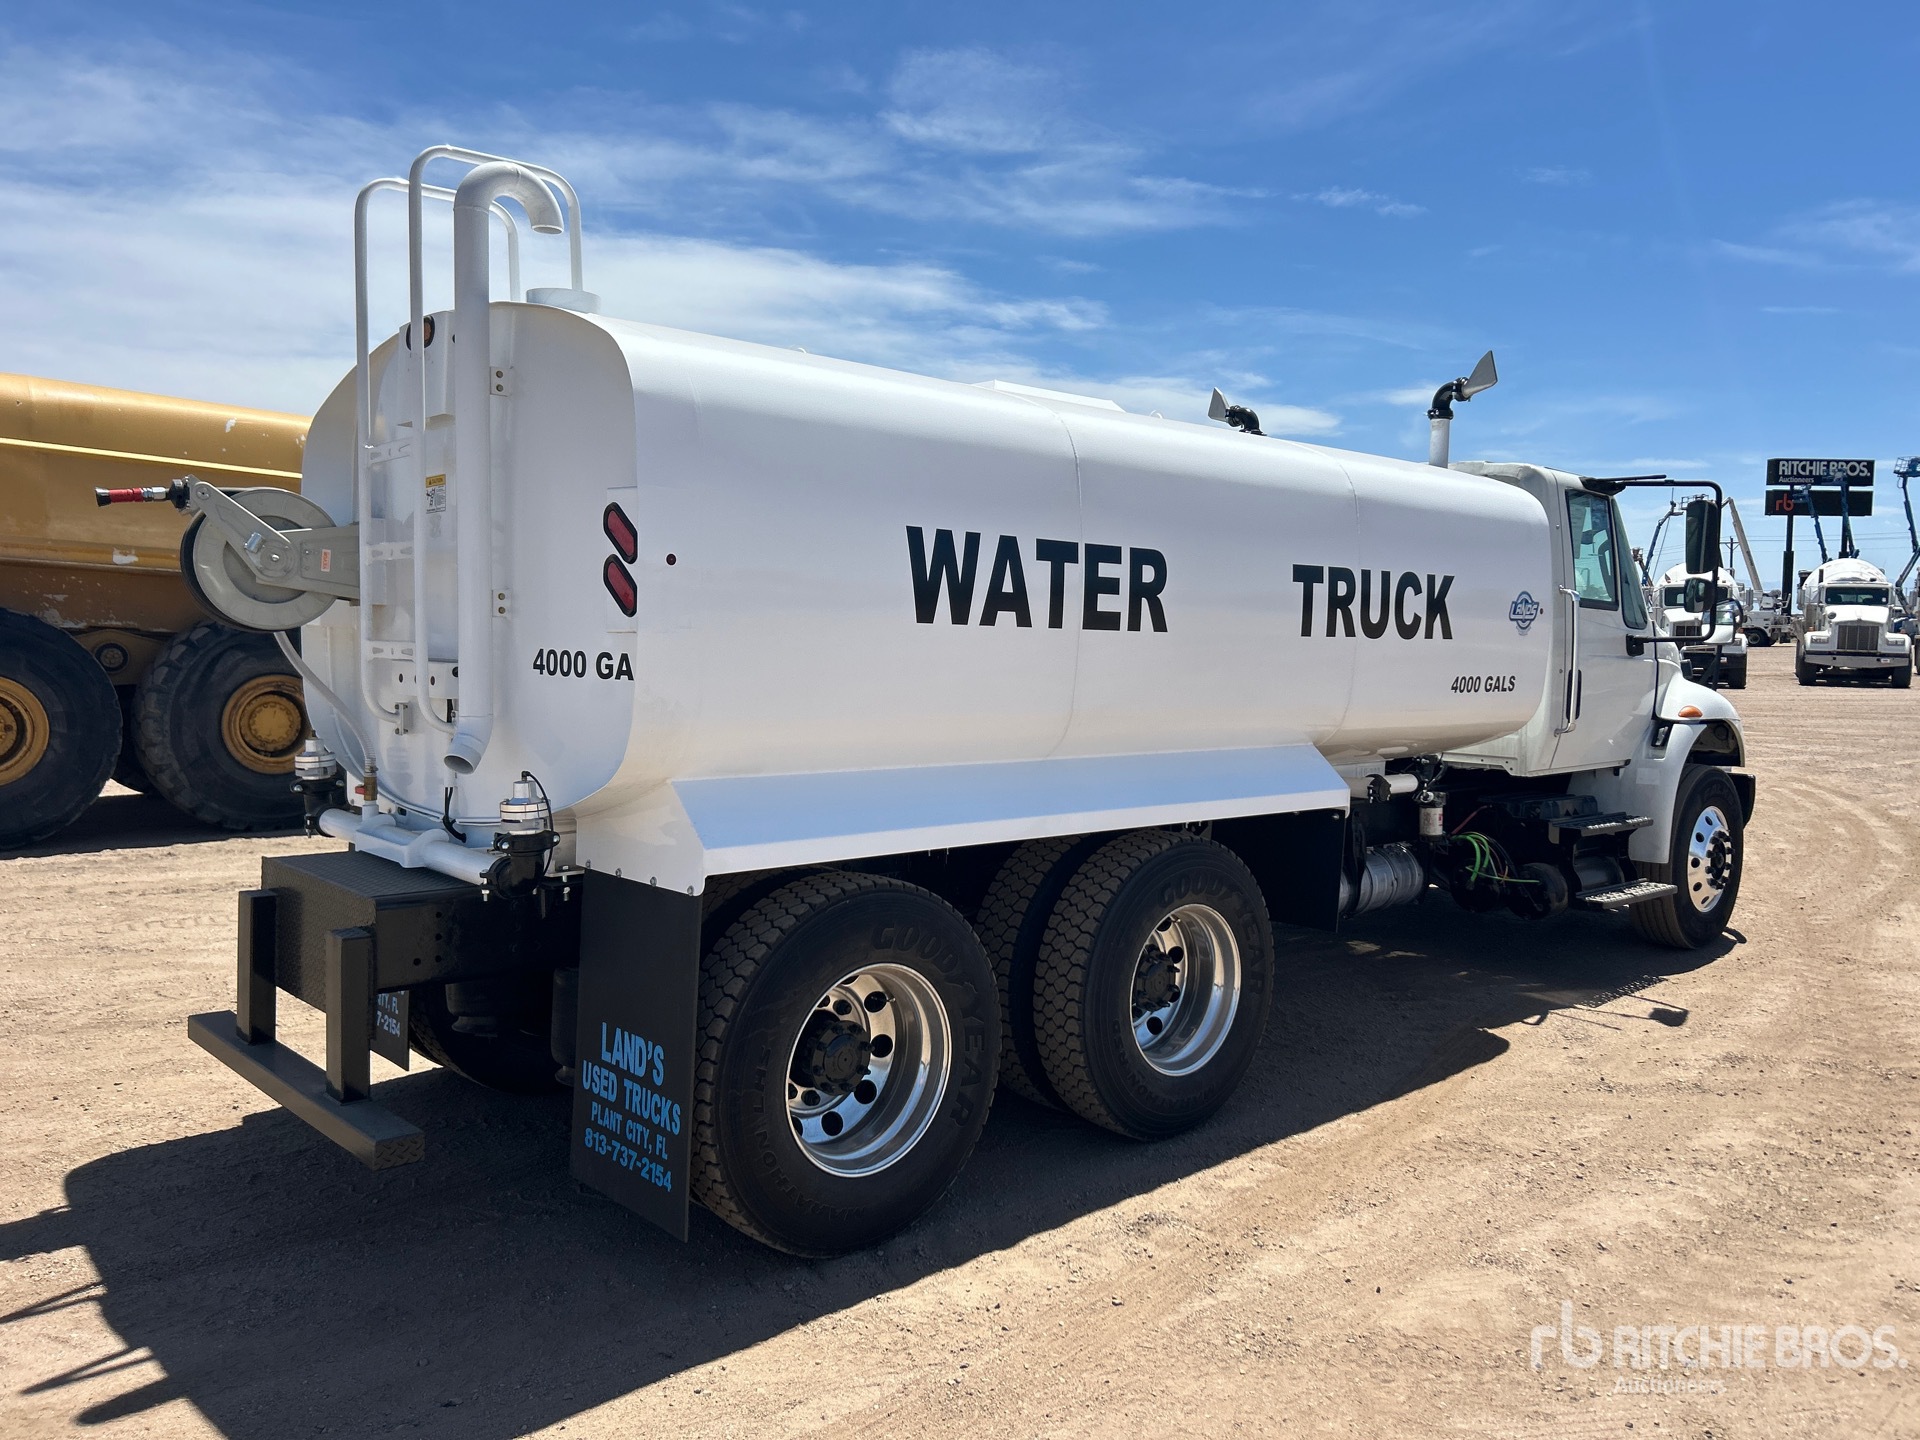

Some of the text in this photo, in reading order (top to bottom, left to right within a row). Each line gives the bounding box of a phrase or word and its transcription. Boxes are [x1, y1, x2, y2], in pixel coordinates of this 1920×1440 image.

[1778, 460, 1827, 476] RITCHIE
[1778, 476, 1814, 484] Auctioneers
[1775, 493, 1794, 512] rb
[906, 525, 1455, 640] WATER TRUCK
[532, 648, 635, 681] 4000 GA
[1450, 675, 1516, 693] 4000 GALS
[601, 1021, 665, 1087] LAND'S
[581, 1059, 681, 1136] USED TRUCKS
[591, 1101, 668, 1161] PLANT CITY, FL
[584, 1127, 672, 1192] 813-737-2154
